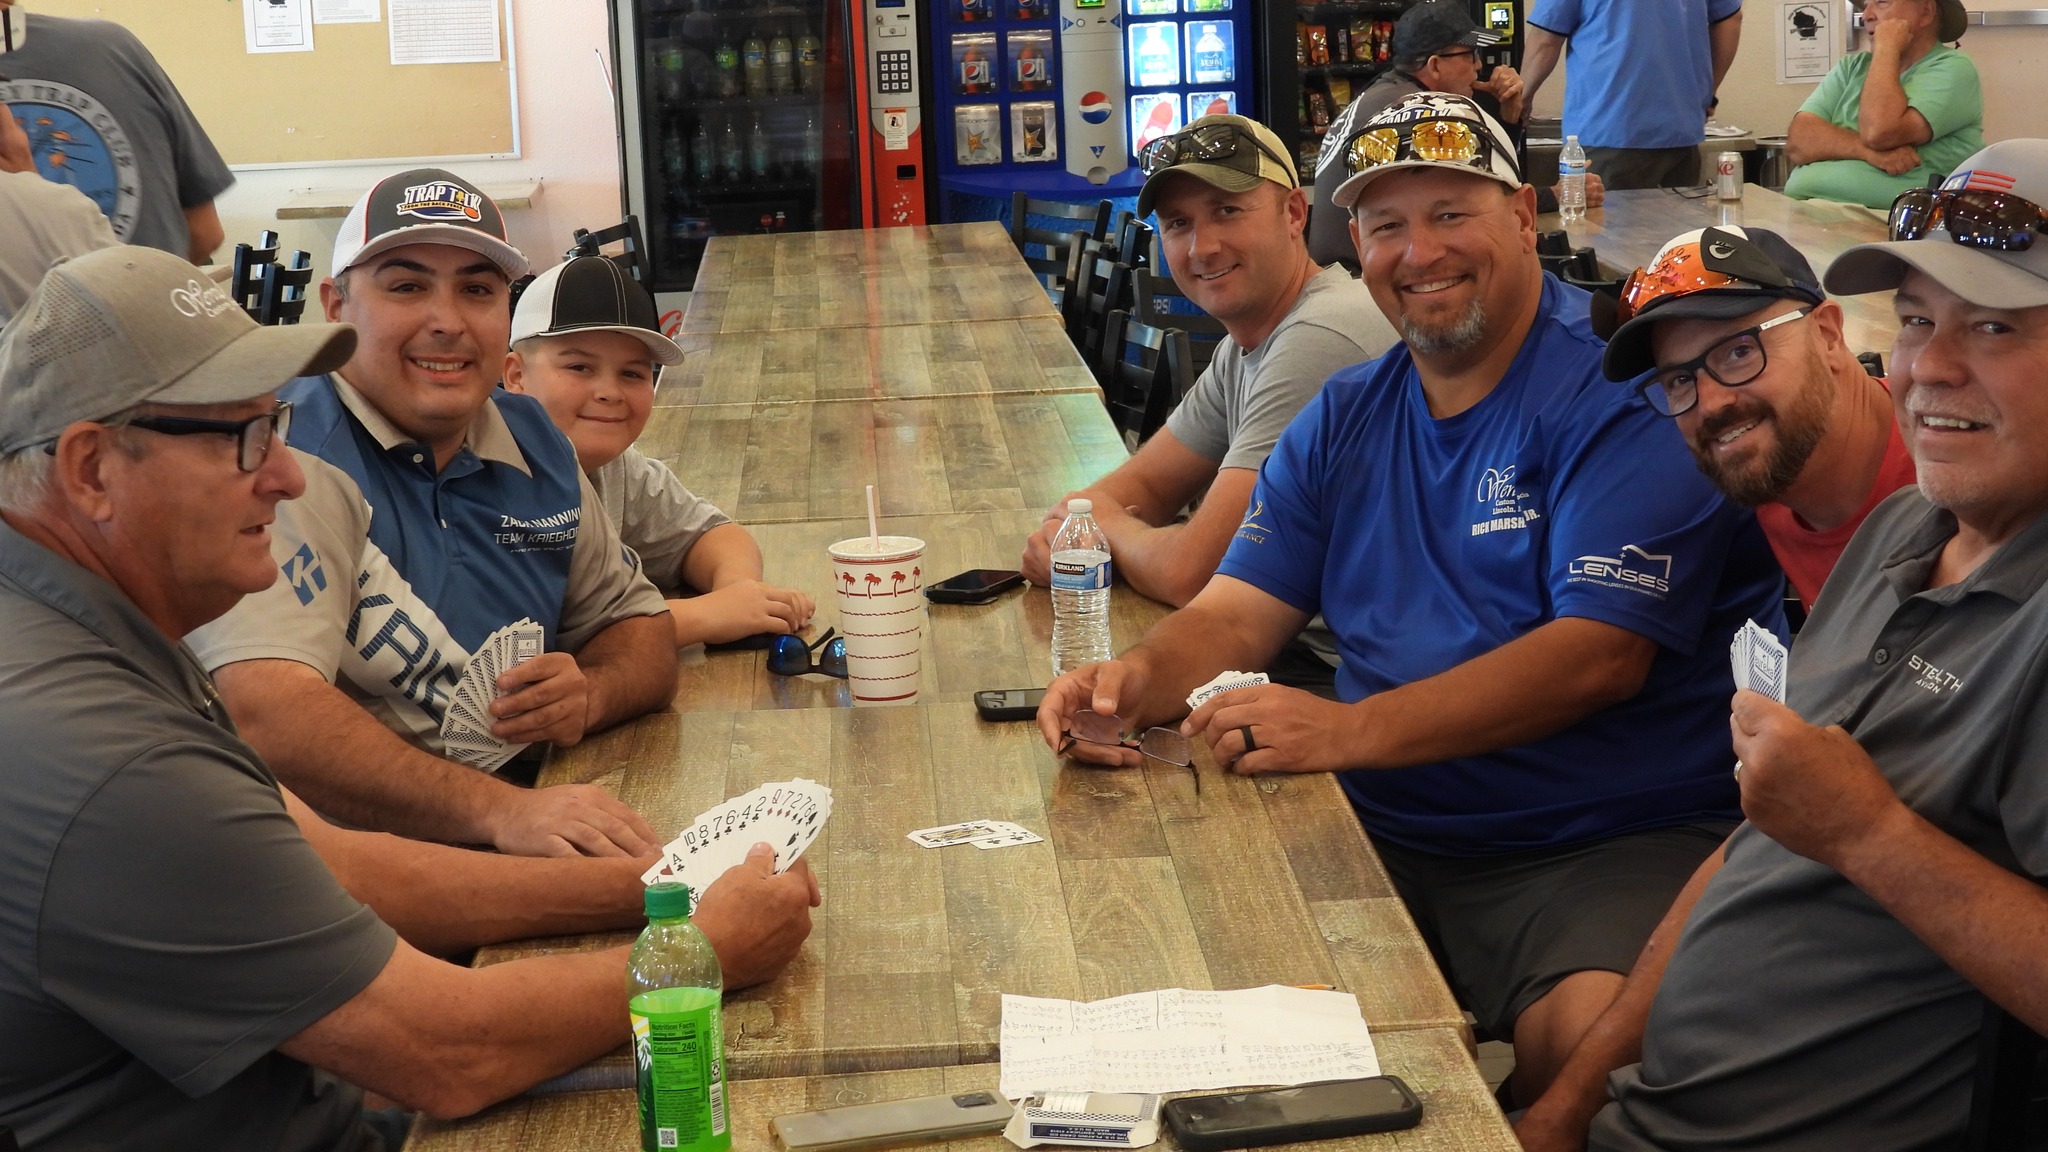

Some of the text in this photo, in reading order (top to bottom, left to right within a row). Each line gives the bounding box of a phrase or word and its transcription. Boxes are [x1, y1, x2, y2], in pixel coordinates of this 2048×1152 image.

[406, 185, 446, 204] TRAP
[1471, 522, 1490, 536] RICK
[1523, 508, 1541, 522] JR.
[494, 532, 524, 544] TEAM
[1055, 564, 1085, 572] KIRKLAND
[1569, 562, 1669, 592] LENSES
[755, 796, 767, 812] 2
[782, 791, 794, 806] 7
[790, 793, 803, 809] 2
[726, 809, 736, 825] 6
[742, 804, 752, 819] 4
[713, 816, 722, 831] 7
[684, 831, 696, 846] 10
[699, 825, 709, 838] 8
[672, 853, 682, 865] A
[651, 1023, 678, 1031] Nutrition
[682, 1041, 697, 1052] 240
